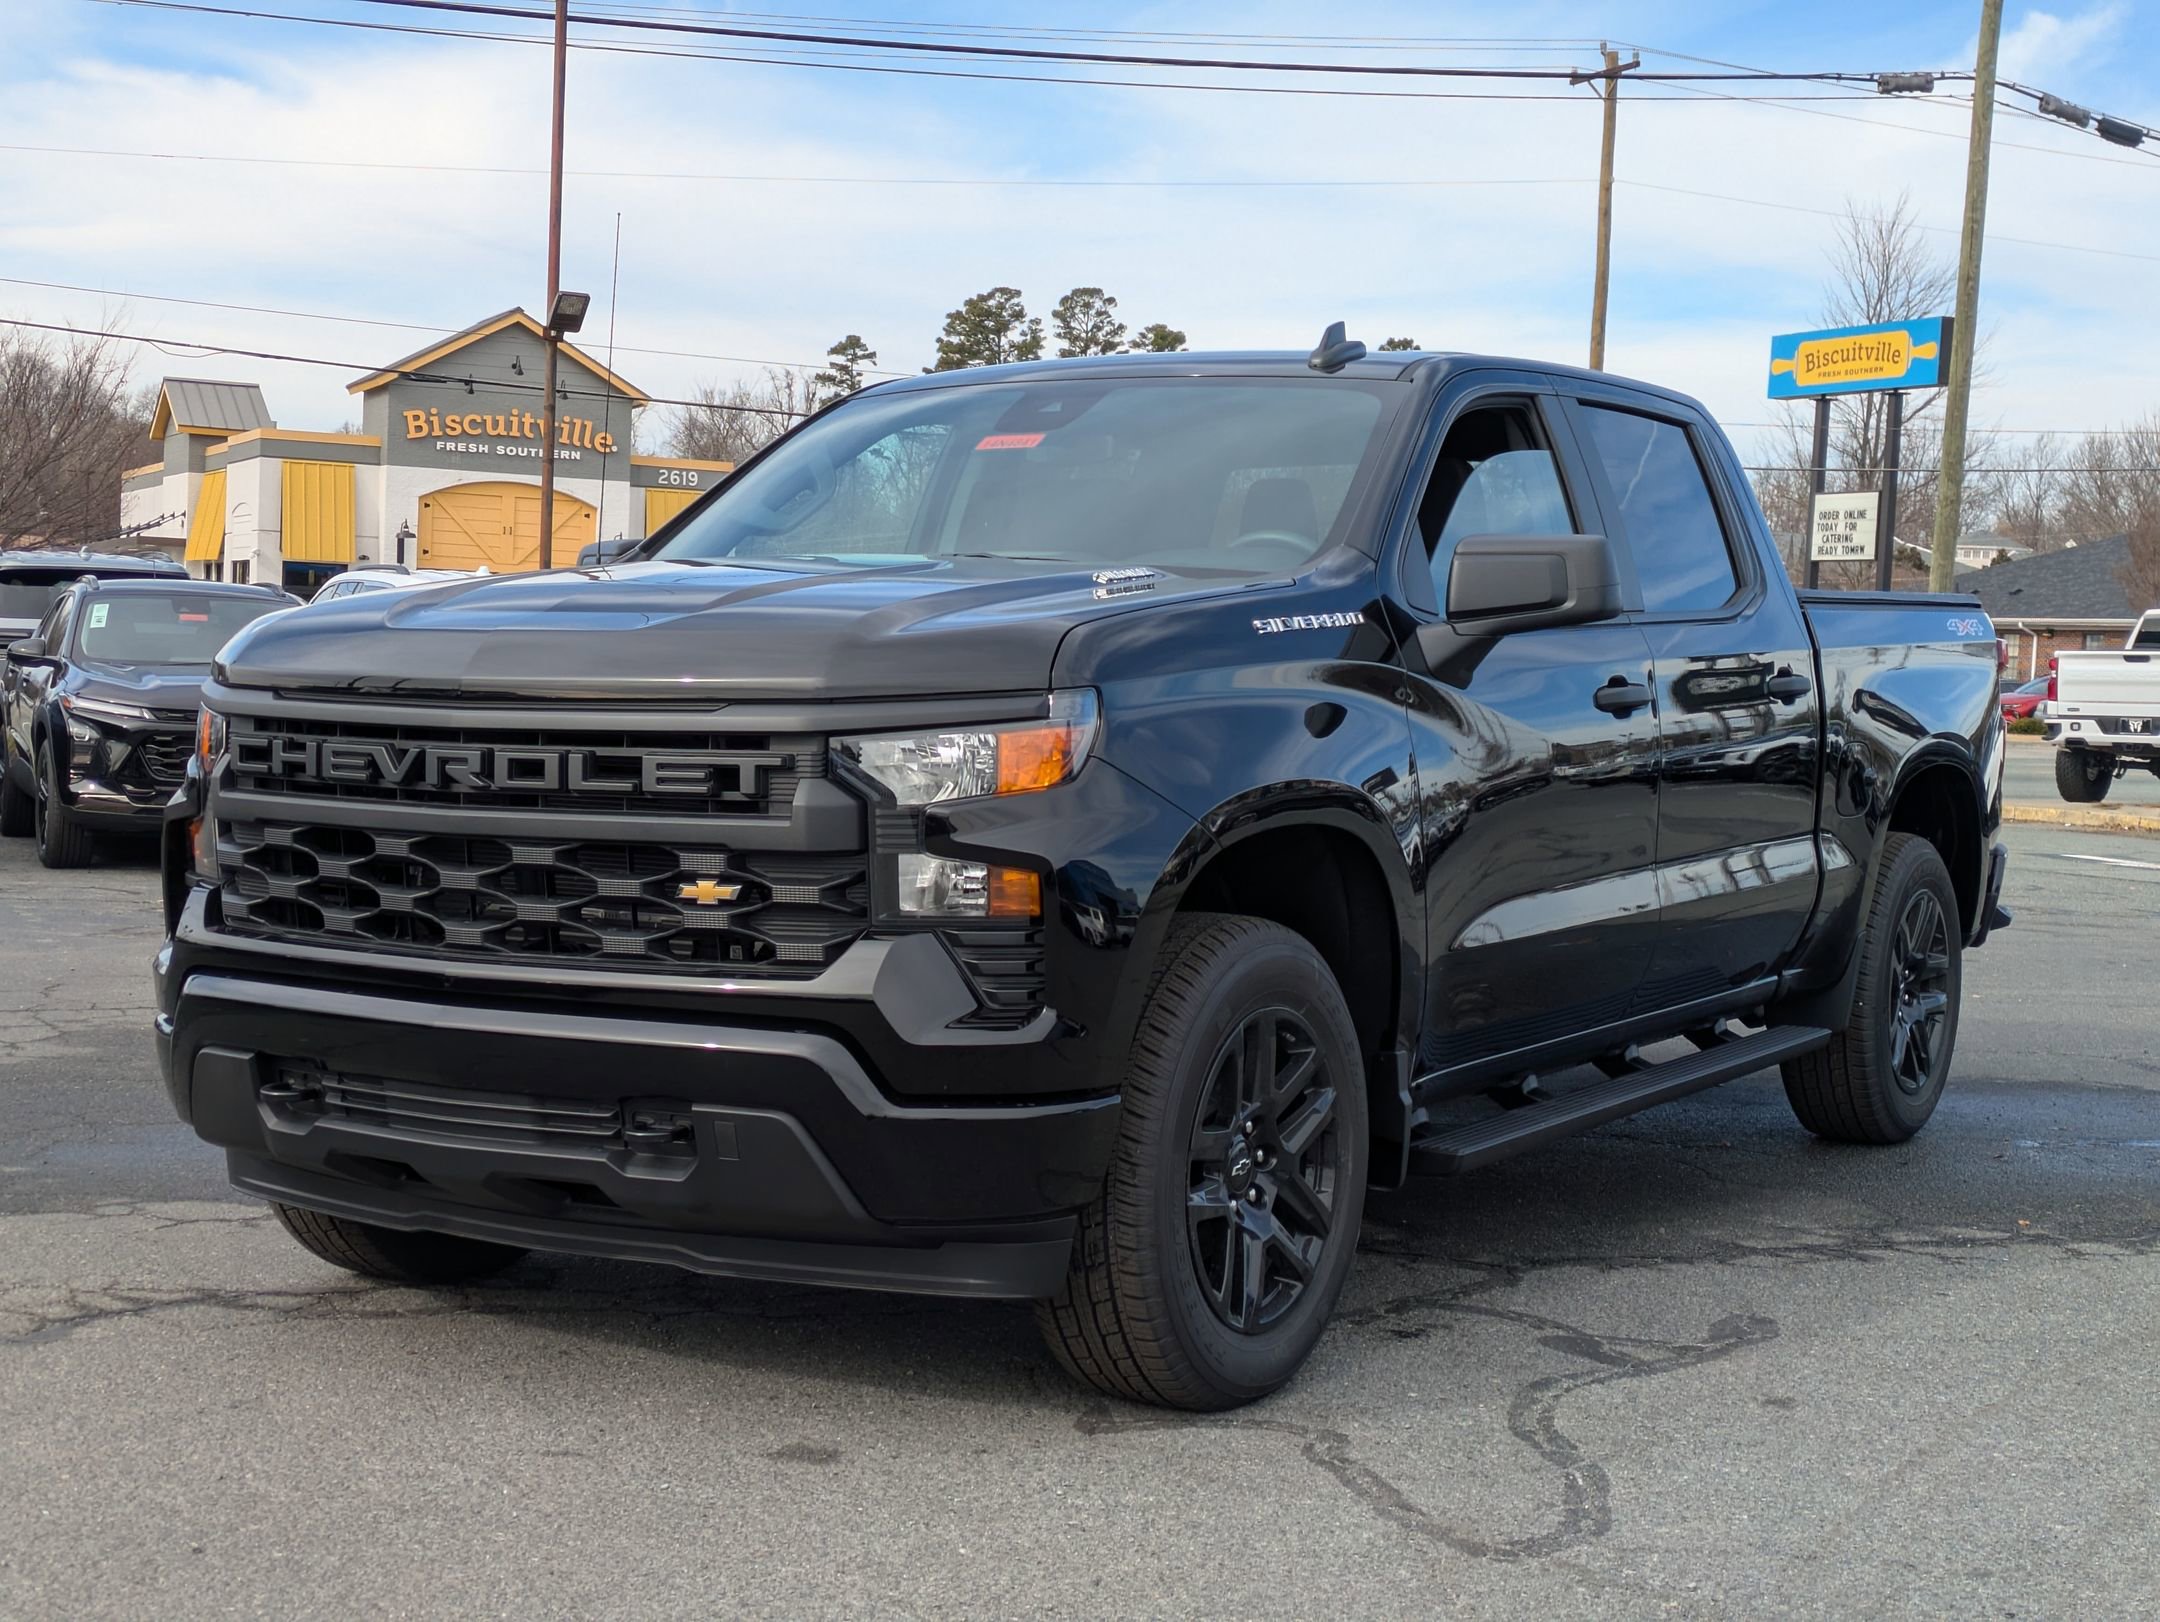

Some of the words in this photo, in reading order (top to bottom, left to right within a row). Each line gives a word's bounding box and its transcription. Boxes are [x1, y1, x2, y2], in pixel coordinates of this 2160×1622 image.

[1805, 341, 1901, 373] Biscuitville
[1817, 370, 1841, 378] FRESH
[1845, 366, 1884, 376] SOUTHERN
[436, 441, 489, 453] FRESH
[658, 469, 698, 486] 2619
[1819, 510, 1840, 520] ORDER
[1844, 510, 1867, 519] ONLINE
[1817, 522, 1838, 532] TODAY
[1845, 522, 1857, 531] FOR
[1822, 534, 1853, 543] CATERING
[1818, 545, 1838, 555] READY
[1842, 545, 1865, 555] TOMRW
[230, 735, 796, 798] CHEVROLET
